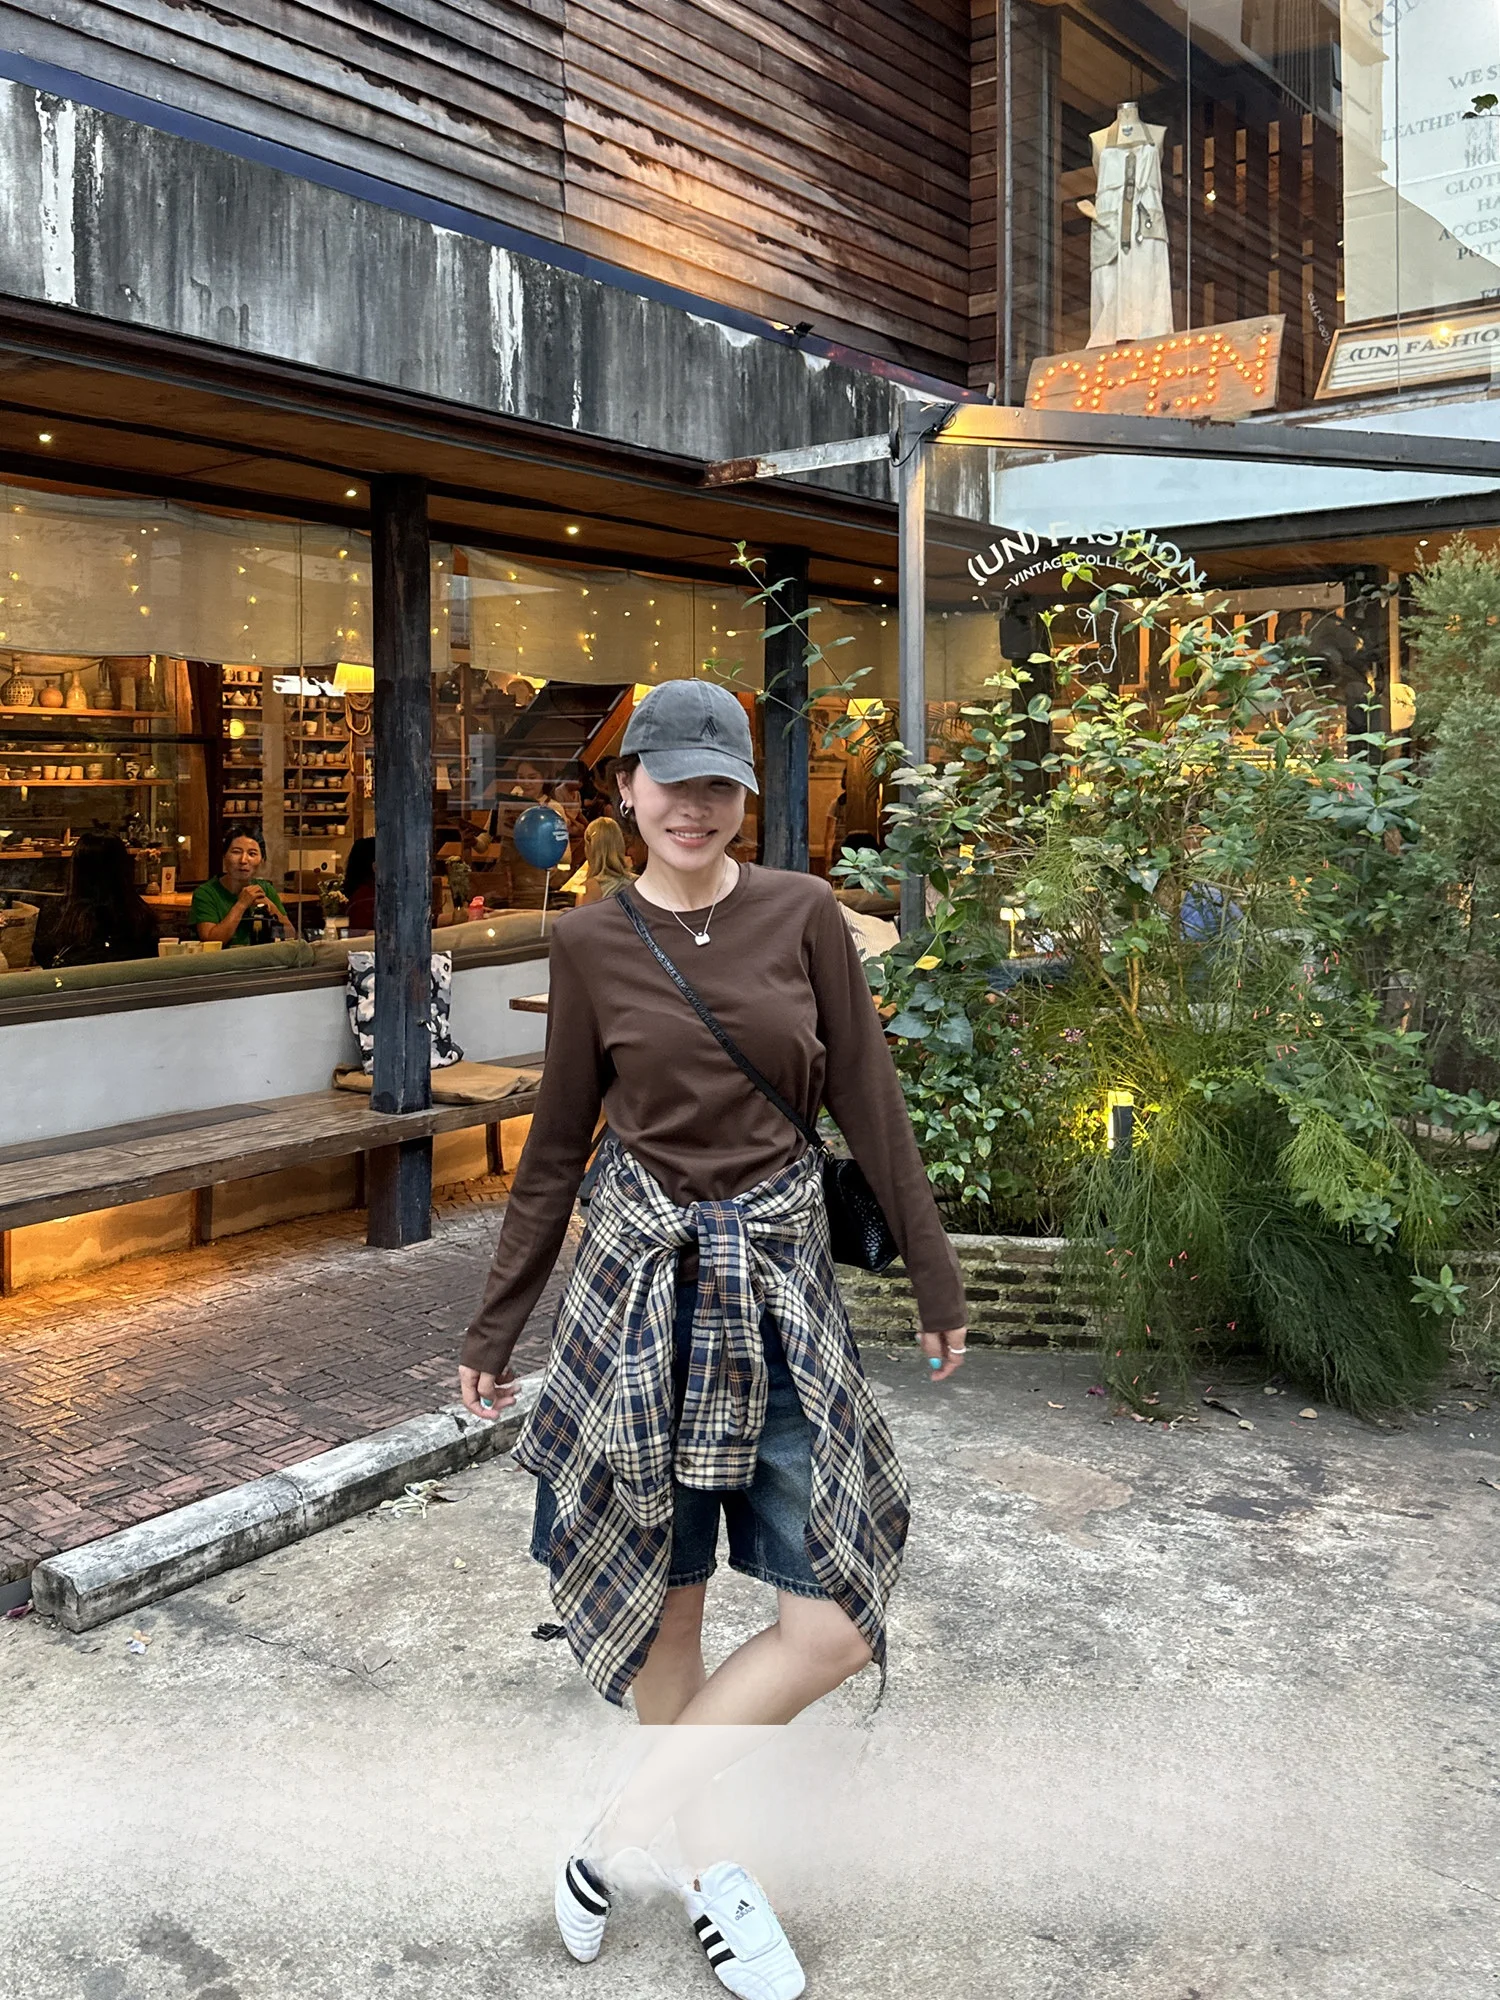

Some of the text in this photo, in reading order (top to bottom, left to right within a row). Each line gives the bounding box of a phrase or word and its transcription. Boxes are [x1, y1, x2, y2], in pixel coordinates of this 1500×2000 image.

[1448, 69, 1483, 89] WE
[1446, 172, 1500, 196] CLOT
[1350, 344, 1398, 362] (UN)
[1031, 332, 1268, 410] OPEN
[968, 520, 1208, 592] (UN) FASHION
